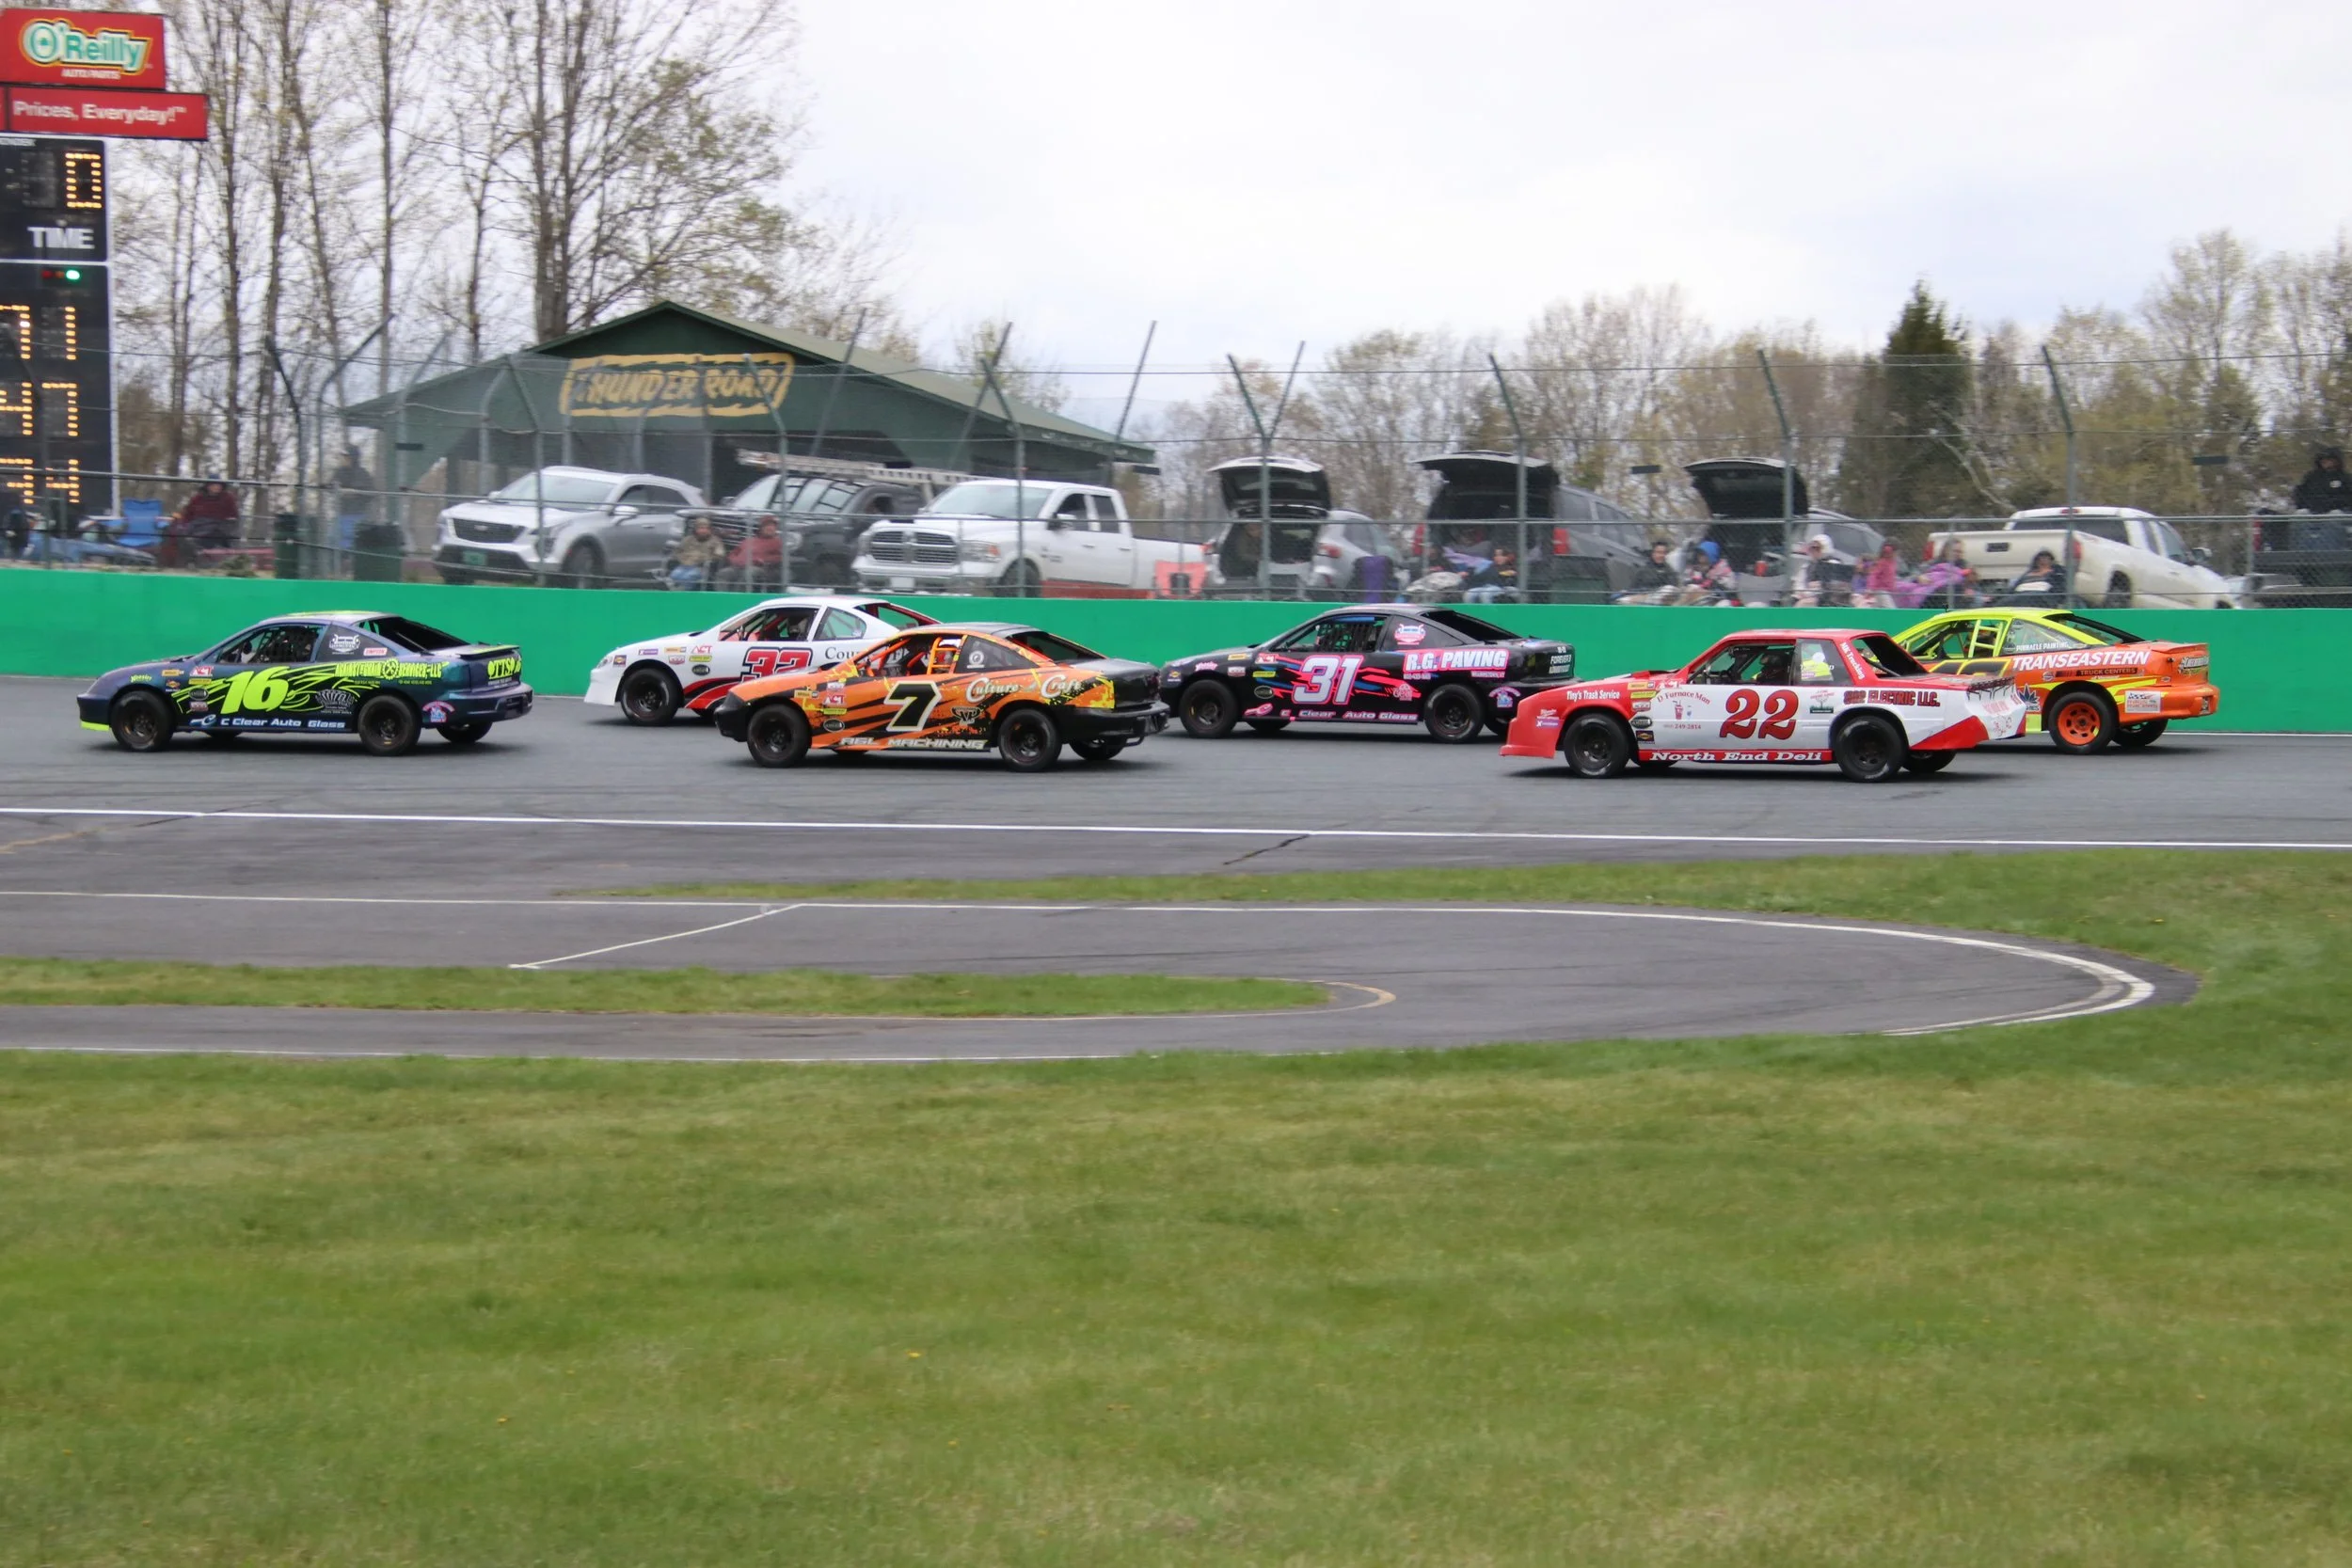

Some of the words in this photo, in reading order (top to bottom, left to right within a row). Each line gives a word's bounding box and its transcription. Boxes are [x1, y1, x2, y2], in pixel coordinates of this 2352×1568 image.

[29, 22, 148, 71] O'Reilly
[13, 100, 79, 120] Prices,
[65, 152, 102, 208] 0
[26, 226, 95, 249] TIME
[572, 369, 698, 404] THUNDER
[704, 368, 777, 399] ROAD
[691, 645, 712, 654] ACT
[2016, 643, 2042, 652] PINNACLE
[1406, 653, 1438, 671] R.G.
[1440, 650, 1507, 669] PAVING
[1846, 651, 1866, 680] Trucking
[2012, 650, 2151, 671] TRANSEASTERN
[220, 665, 290, 715] 16
[965, 676, 1021, 704] Culture
[1041, 673, 1083, 699] Craft
[1293, 655, 1364, 705] 31
[883, 681, 943, 732] 7
[1566, 690, 1582, 702] Tiny's
[1583, 690, 1597, 700] Trash
[1598, 690, 1620, 700] Service
[1695, 692, 1711, 705] Man
[1867, 689, 1915, 705] ELECTRIC
[1917, 691, 1941, 707] LLC.
[232, 718, 268, 727] Clear
[270, 719, 302, 727] Auto
[308, 720, 345, 729] Glass
[1297, 709, 1336, 719] Clear
[1343, 711, 1375, 720] Auto
[1378, 711, 1418, 721] Glass
[1719, 688, 1799, 740] 22
[887, 738, 988, 750] MACHINING
[1649, 752, 1716, 761] North
[1721, 752, 1769, 761] End
[1773, 752, 1822, 761] Deli
